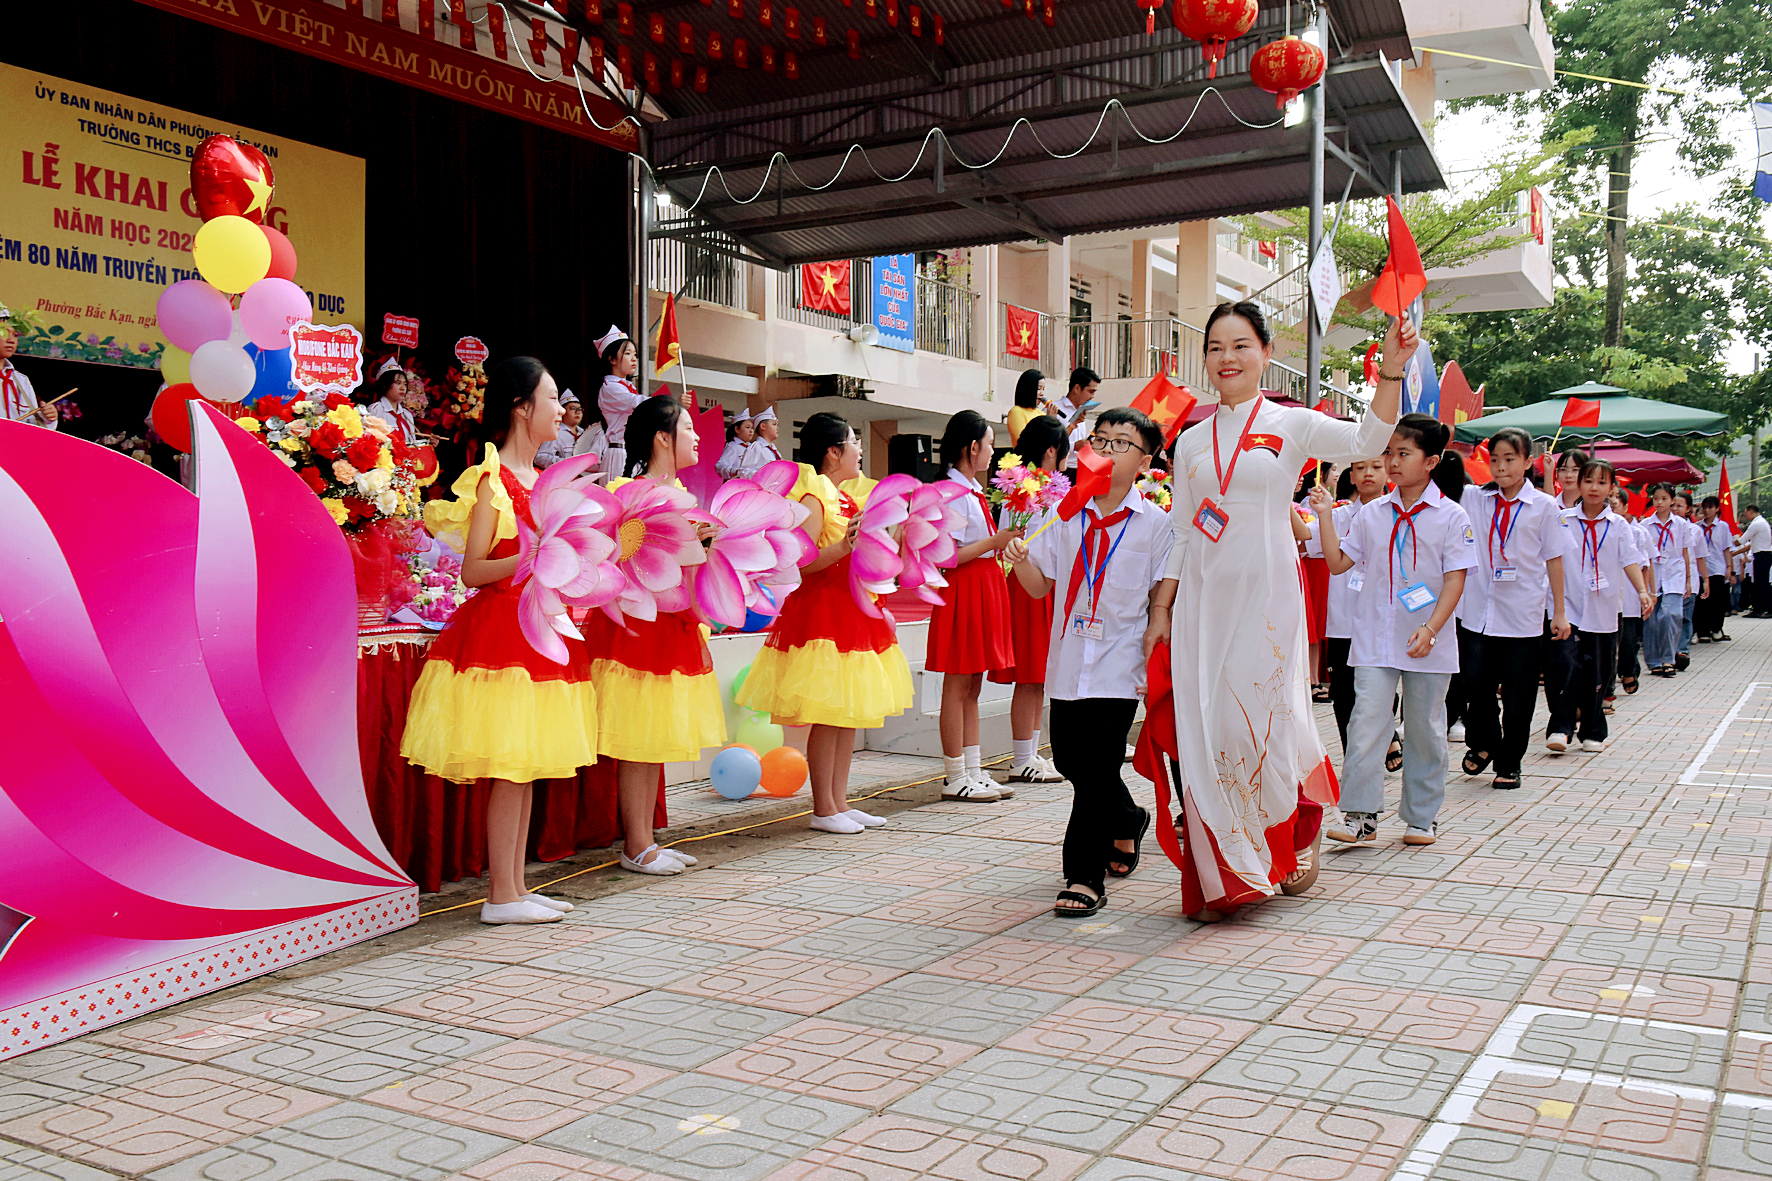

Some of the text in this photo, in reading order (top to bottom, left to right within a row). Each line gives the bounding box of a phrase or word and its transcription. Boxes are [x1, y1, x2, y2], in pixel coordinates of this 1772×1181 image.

[252, 0, 583, 126] VIỆT NAM MUÔN NĂM
[35, 80, 56, 101] ỦY
[60, 92, 90, 111] BAN
[94, 101, 134, 122] NHÂN
[137, 112, 166, 130] DÂN
[77, 118, 140, 146] TRƯỜNG
[145, 135, 182, 155] THCS
[22, 142, 62, 190] LỄ
[74, 161, 168, 212] KHAI
[53, 206, 196, 253] NĂM HỌC 202
[28, 243, 50, 266] 80
[56, 245, 97, 274] NĂM
[102, 255, 167, 285] TRUYỀN
[318, 293, 345, 317] DỤC
[36, 298, 82, 319] Phường
[85, 303, 107, 320] Bắc
[137, 314, 157, 329] ngà
